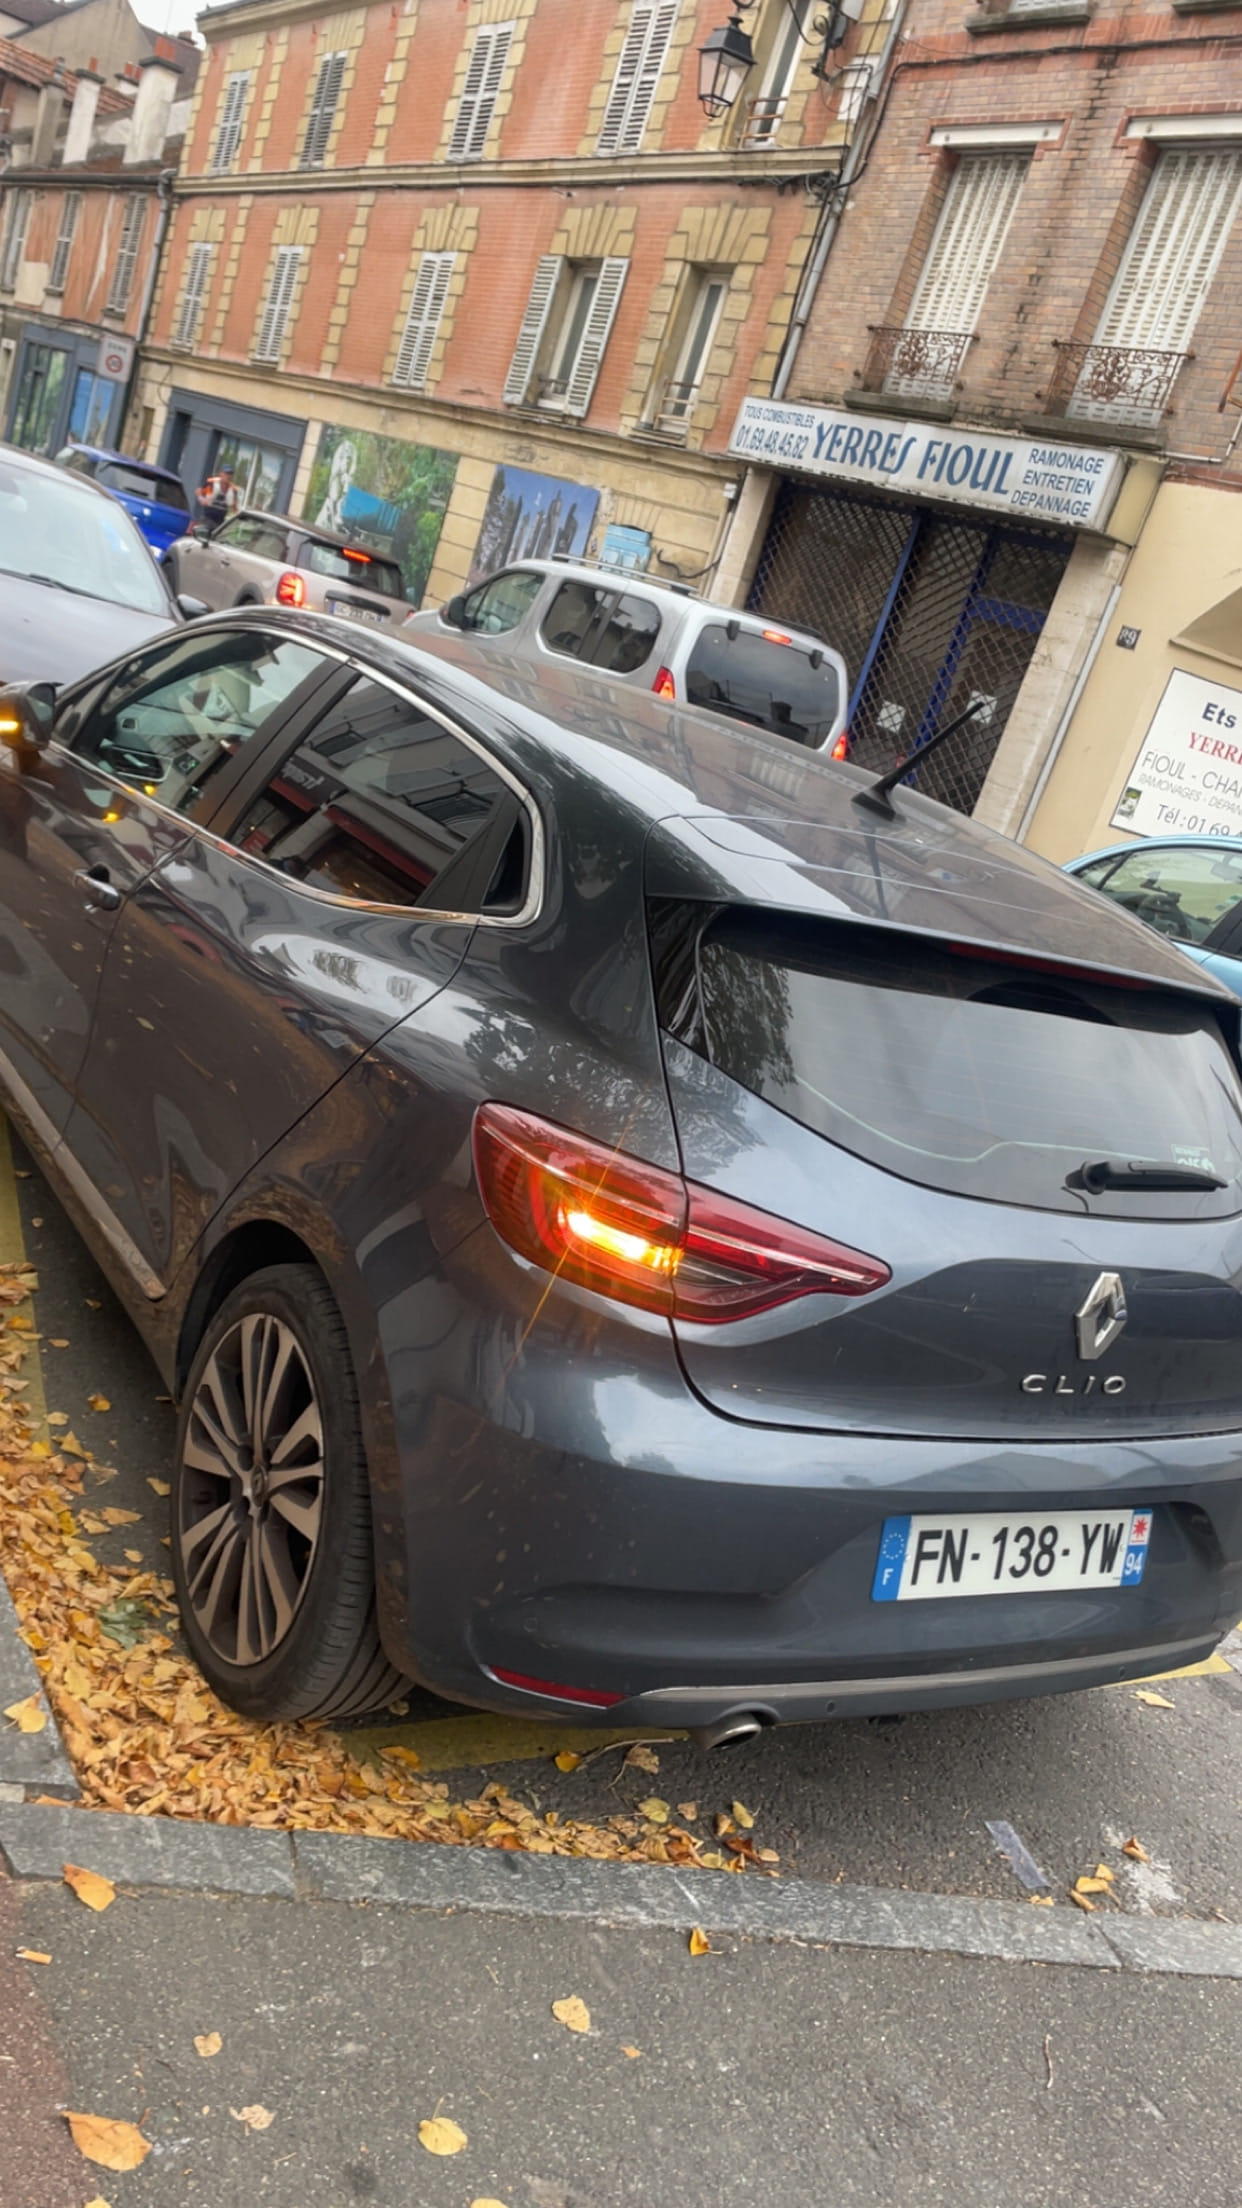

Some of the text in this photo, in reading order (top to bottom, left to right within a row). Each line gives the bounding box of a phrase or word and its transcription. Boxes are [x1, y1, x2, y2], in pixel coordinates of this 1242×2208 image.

[745, 405, 816, 429] TOUS COMBUSTIBLES
[812, 421, 1014, 495] YERRES FIOUL
[1028, 448, 1105, 474] RAMONAGE
[1022, 469, 1096, 496] ENTRETIEN
[1010, 490, 1091, 518] DEPANNAGE
[1202, 702, 1237, 728] Ets
[1142, 751, 1186, 780] FIOUL
[1202, 771, 1242, 798] CHA
[1021, 1373, 1127, 1394] CLIO
[881, 1522, 1144, 1586] F FN-138-YW 94
